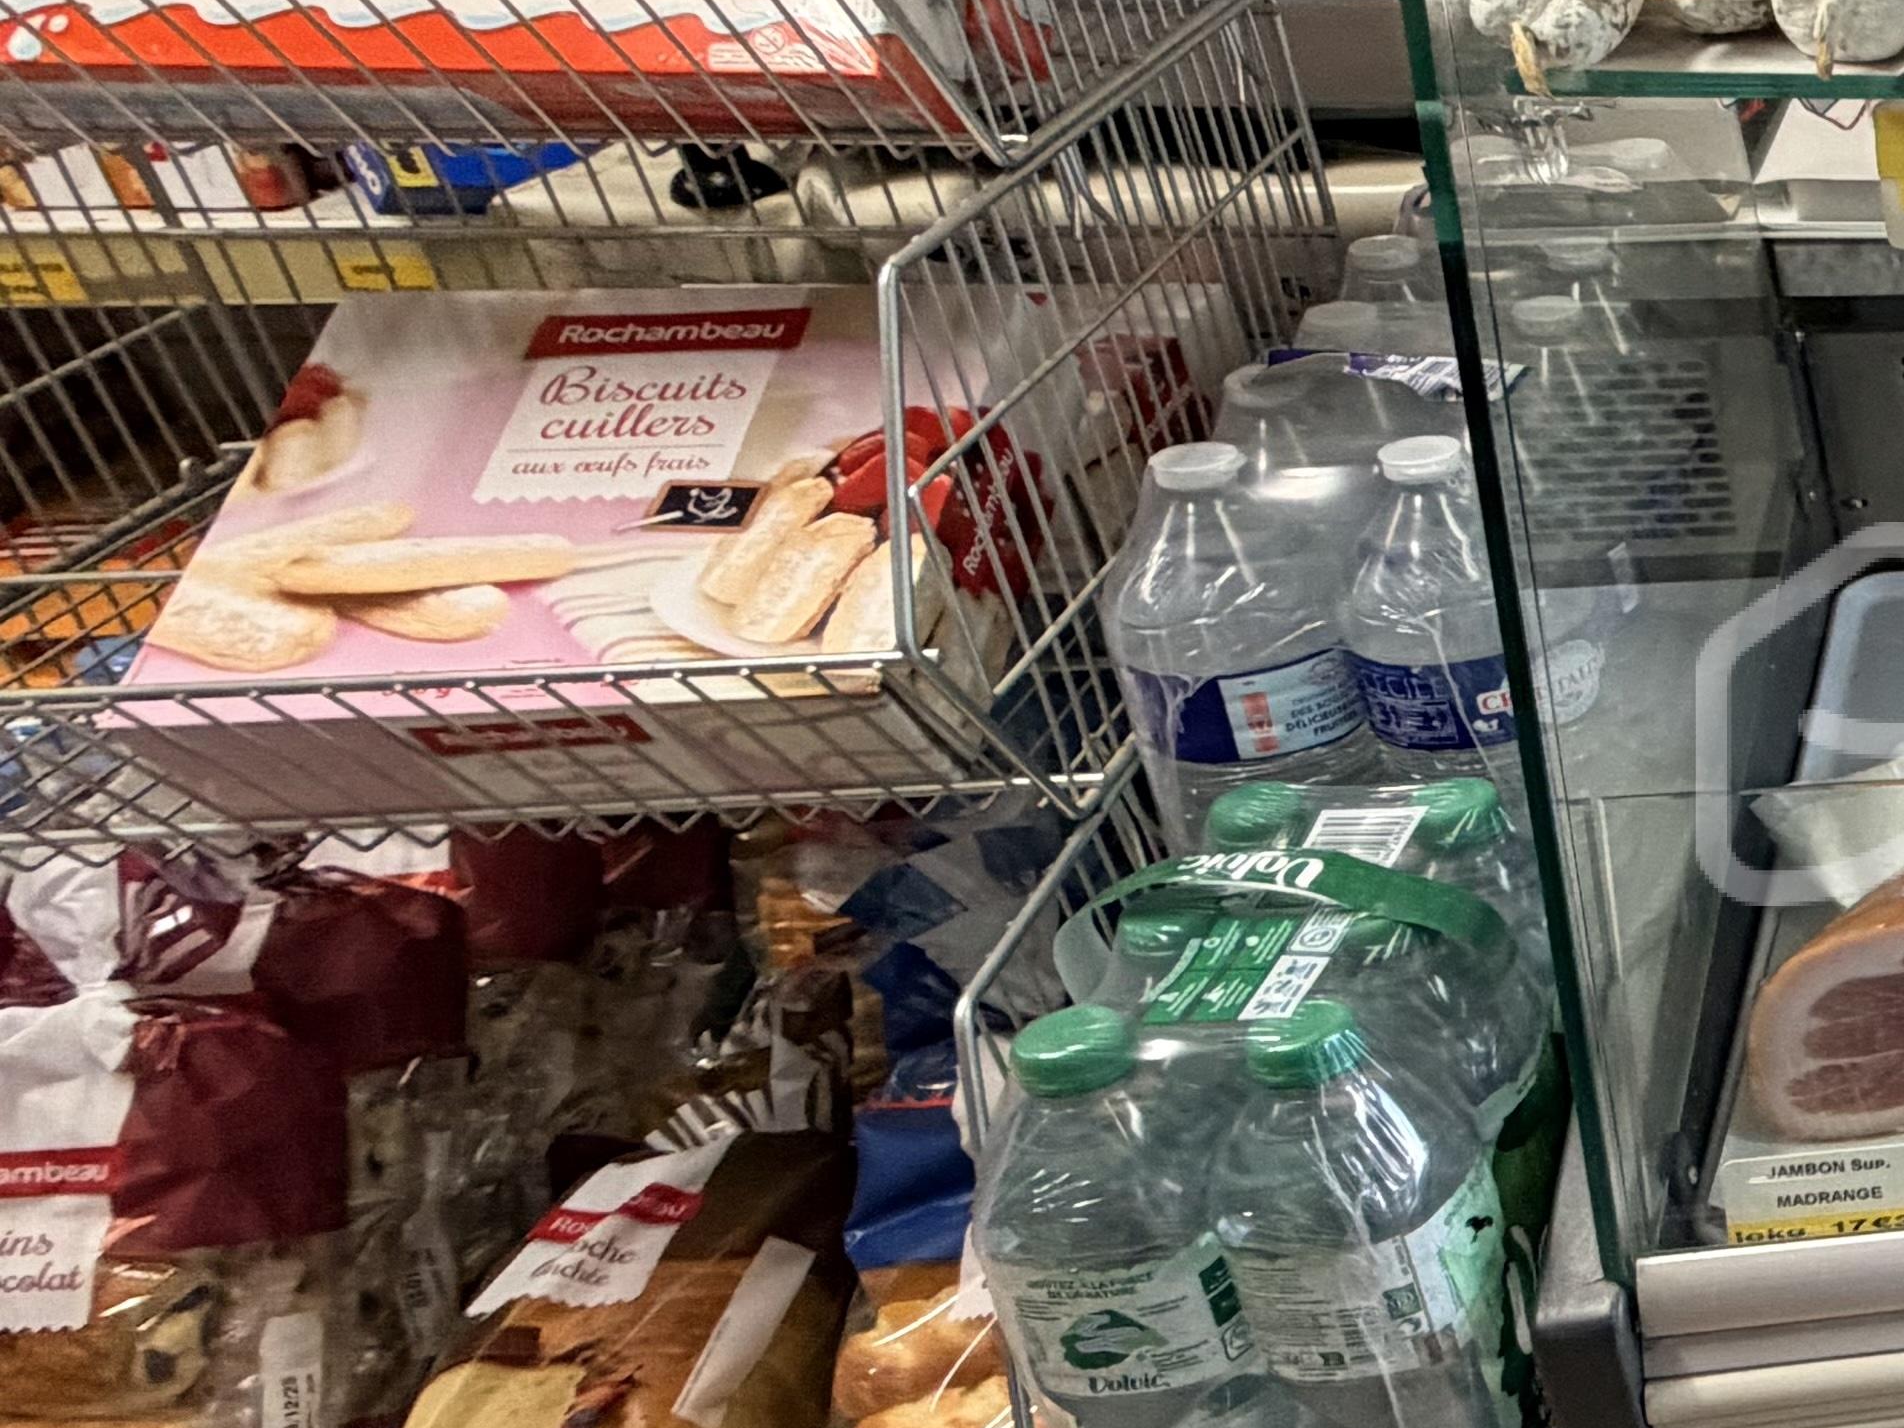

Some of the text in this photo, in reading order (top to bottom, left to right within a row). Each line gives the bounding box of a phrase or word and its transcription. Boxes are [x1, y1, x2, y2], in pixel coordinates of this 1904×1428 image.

[559, 321, 785, 345] Rochambeau
[540, 365, 747, 406] Biscuits
[541, 403, 715, 440] cuillers
[512, 461, 565, 476] aux
[645, 451, 710, 477] frais
[1177, 851, 1324, 889] Volvic
[1768, 1157, 1891, 1181] JAMBON Sup.
[1777, 1186, 1882, 1209] MADRANGE
